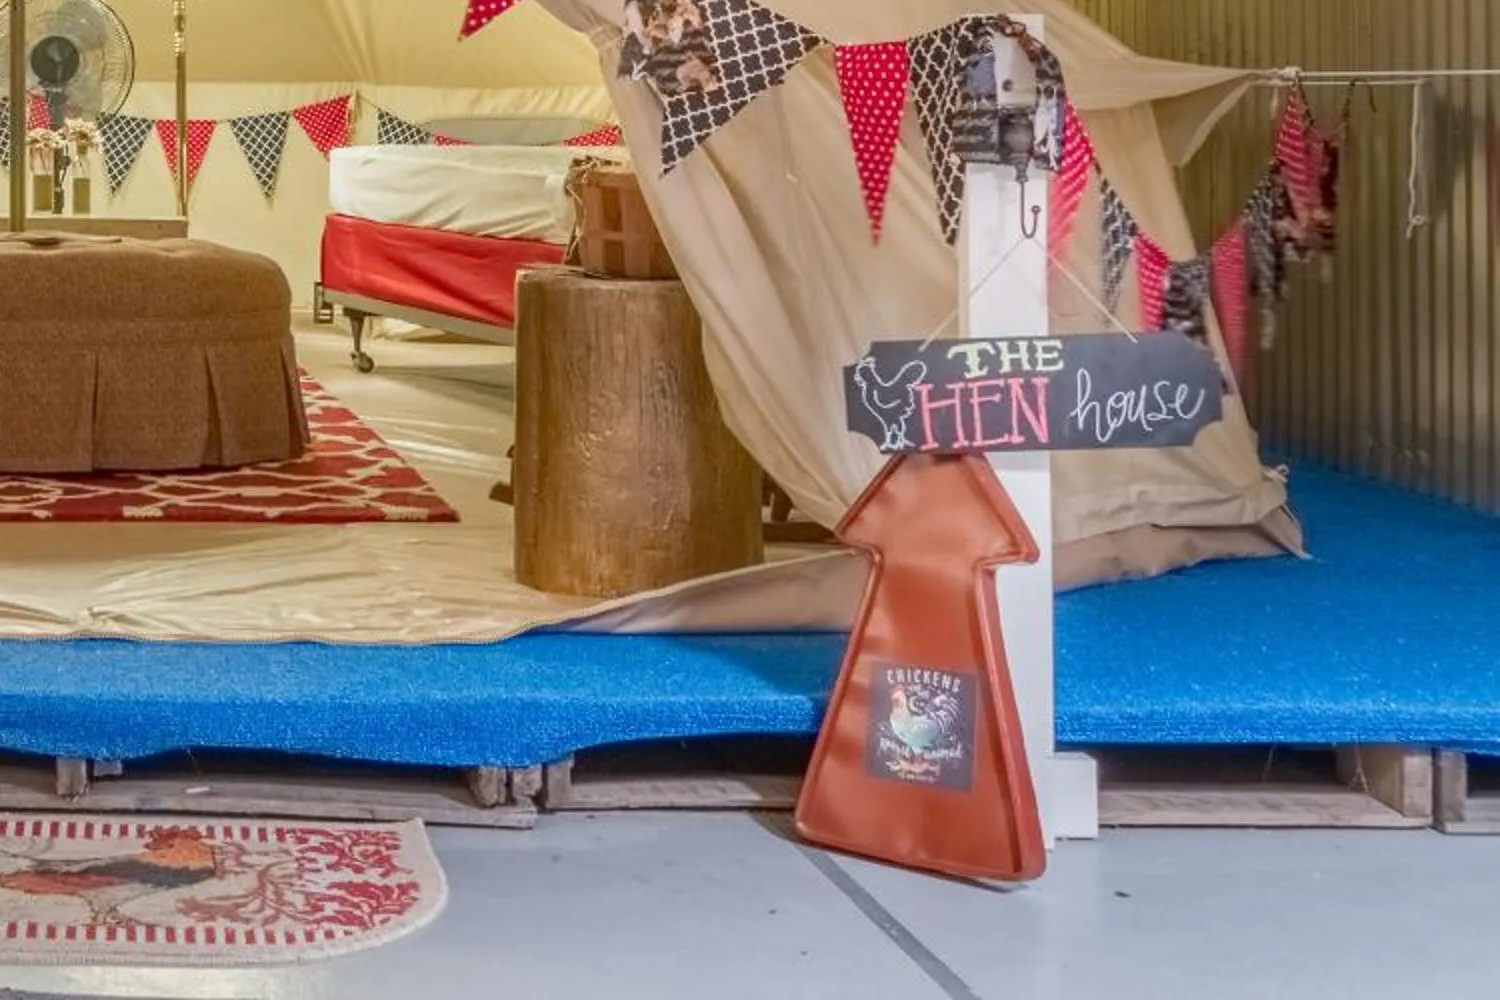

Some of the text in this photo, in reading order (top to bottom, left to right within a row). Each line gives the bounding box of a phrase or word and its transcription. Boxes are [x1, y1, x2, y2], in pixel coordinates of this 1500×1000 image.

[947, 340, 1065, 378] THE
[913, 367, 1205, 451] HEN house
